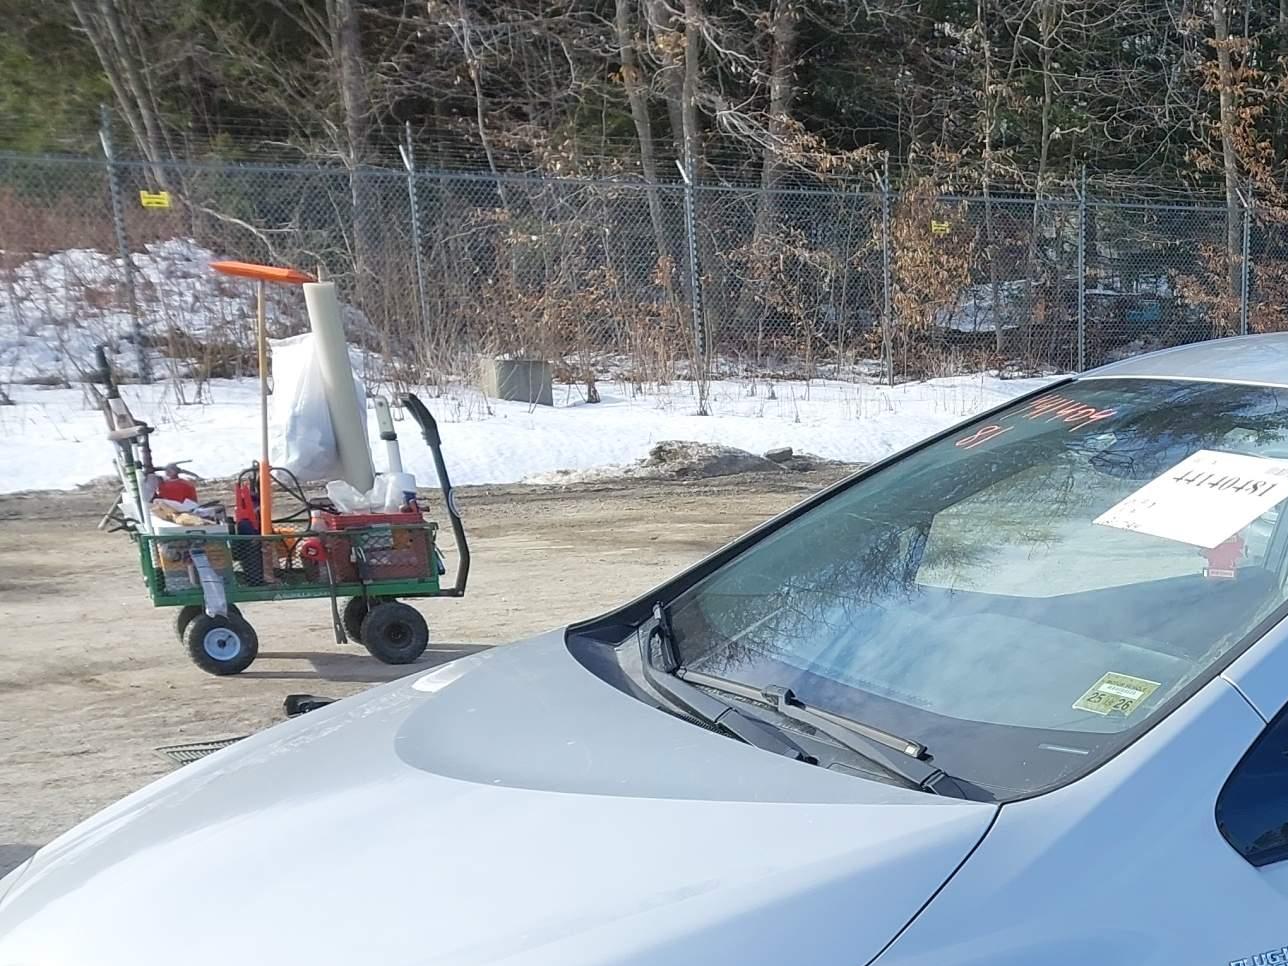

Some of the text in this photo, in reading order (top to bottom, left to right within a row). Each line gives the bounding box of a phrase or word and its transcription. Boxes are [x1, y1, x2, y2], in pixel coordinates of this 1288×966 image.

[955, 424, 1015, 450] 81
[1171, 469, 1278, 498] 44140481
[1087, 692, 1106, 704] 25
[1113, 698, 1134, 711] 26
